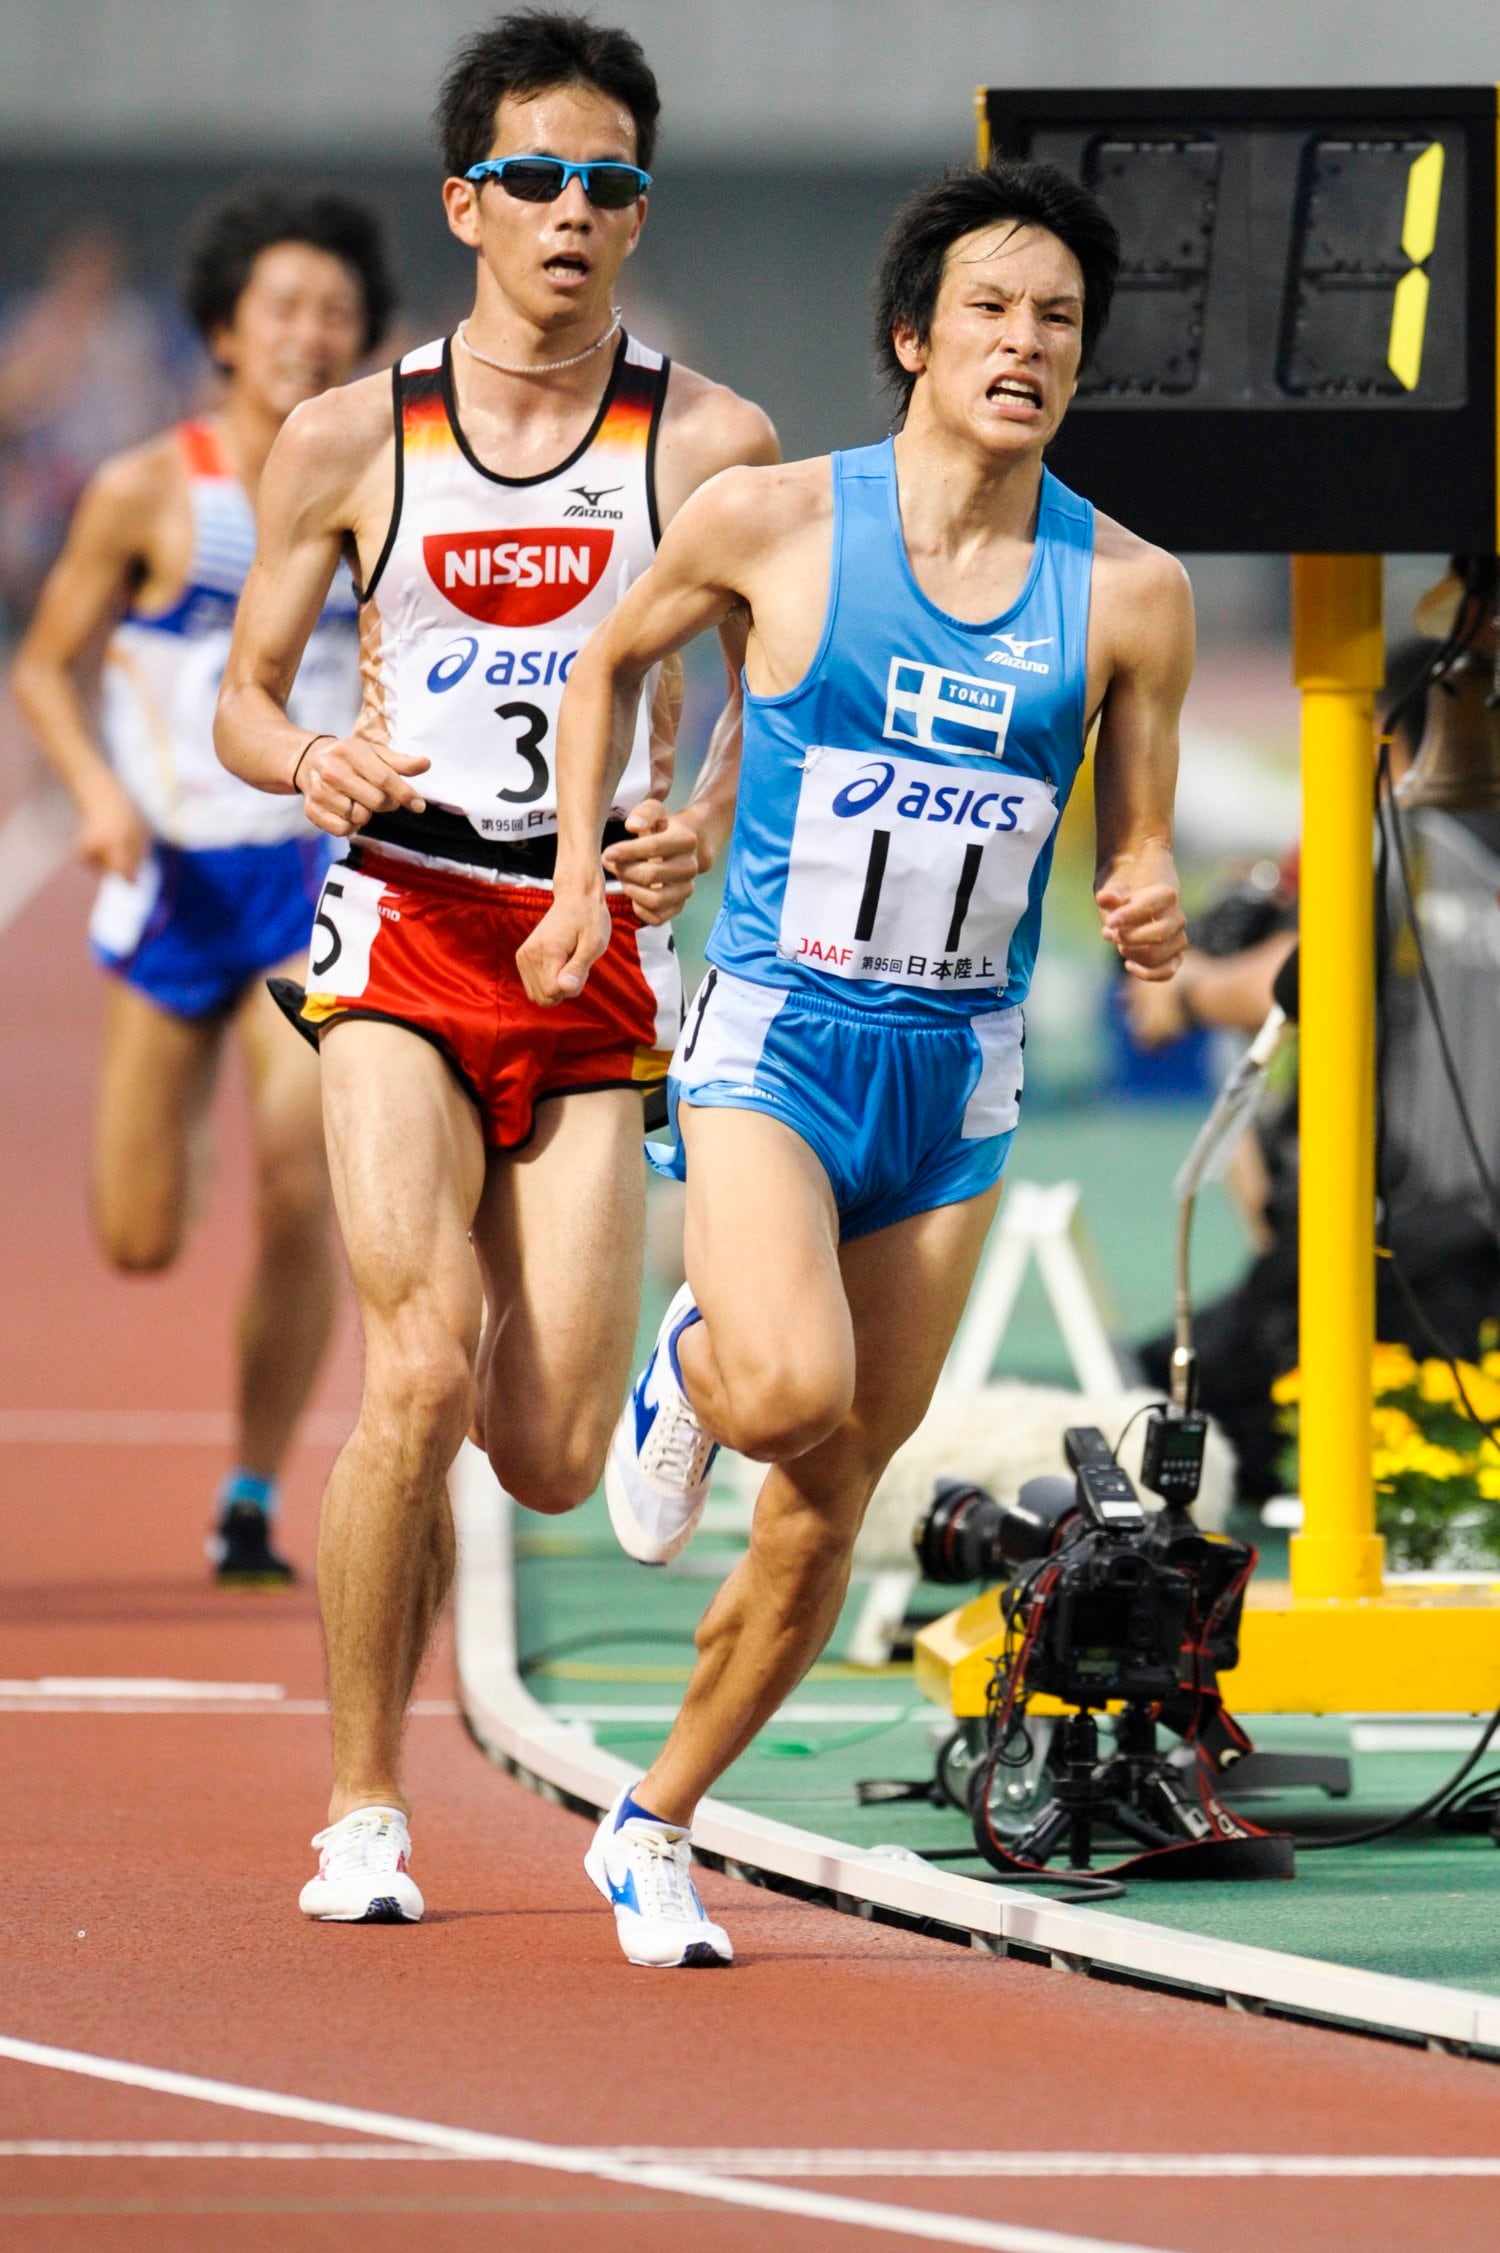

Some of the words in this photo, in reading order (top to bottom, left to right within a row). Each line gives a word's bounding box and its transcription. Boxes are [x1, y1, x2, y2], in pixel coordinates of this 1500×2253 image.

[1388, 141, 1445, 392] 1
[563, 505, 623, 519] MIZUNO
[445, 543, 590, 588] NISSIN
[485, 650, 579, 685] asic
[984, 650, 1049, 674] MIZUNO
[949, 684, 996, 708] TOKAI
[494, 701, 549, 803] 3
[896, 781, 1024, 832] asics
[854, 829, 984, 952] 11
[312, 881, 345, 977] 5
[797, 937, 854, 967] JAAF
